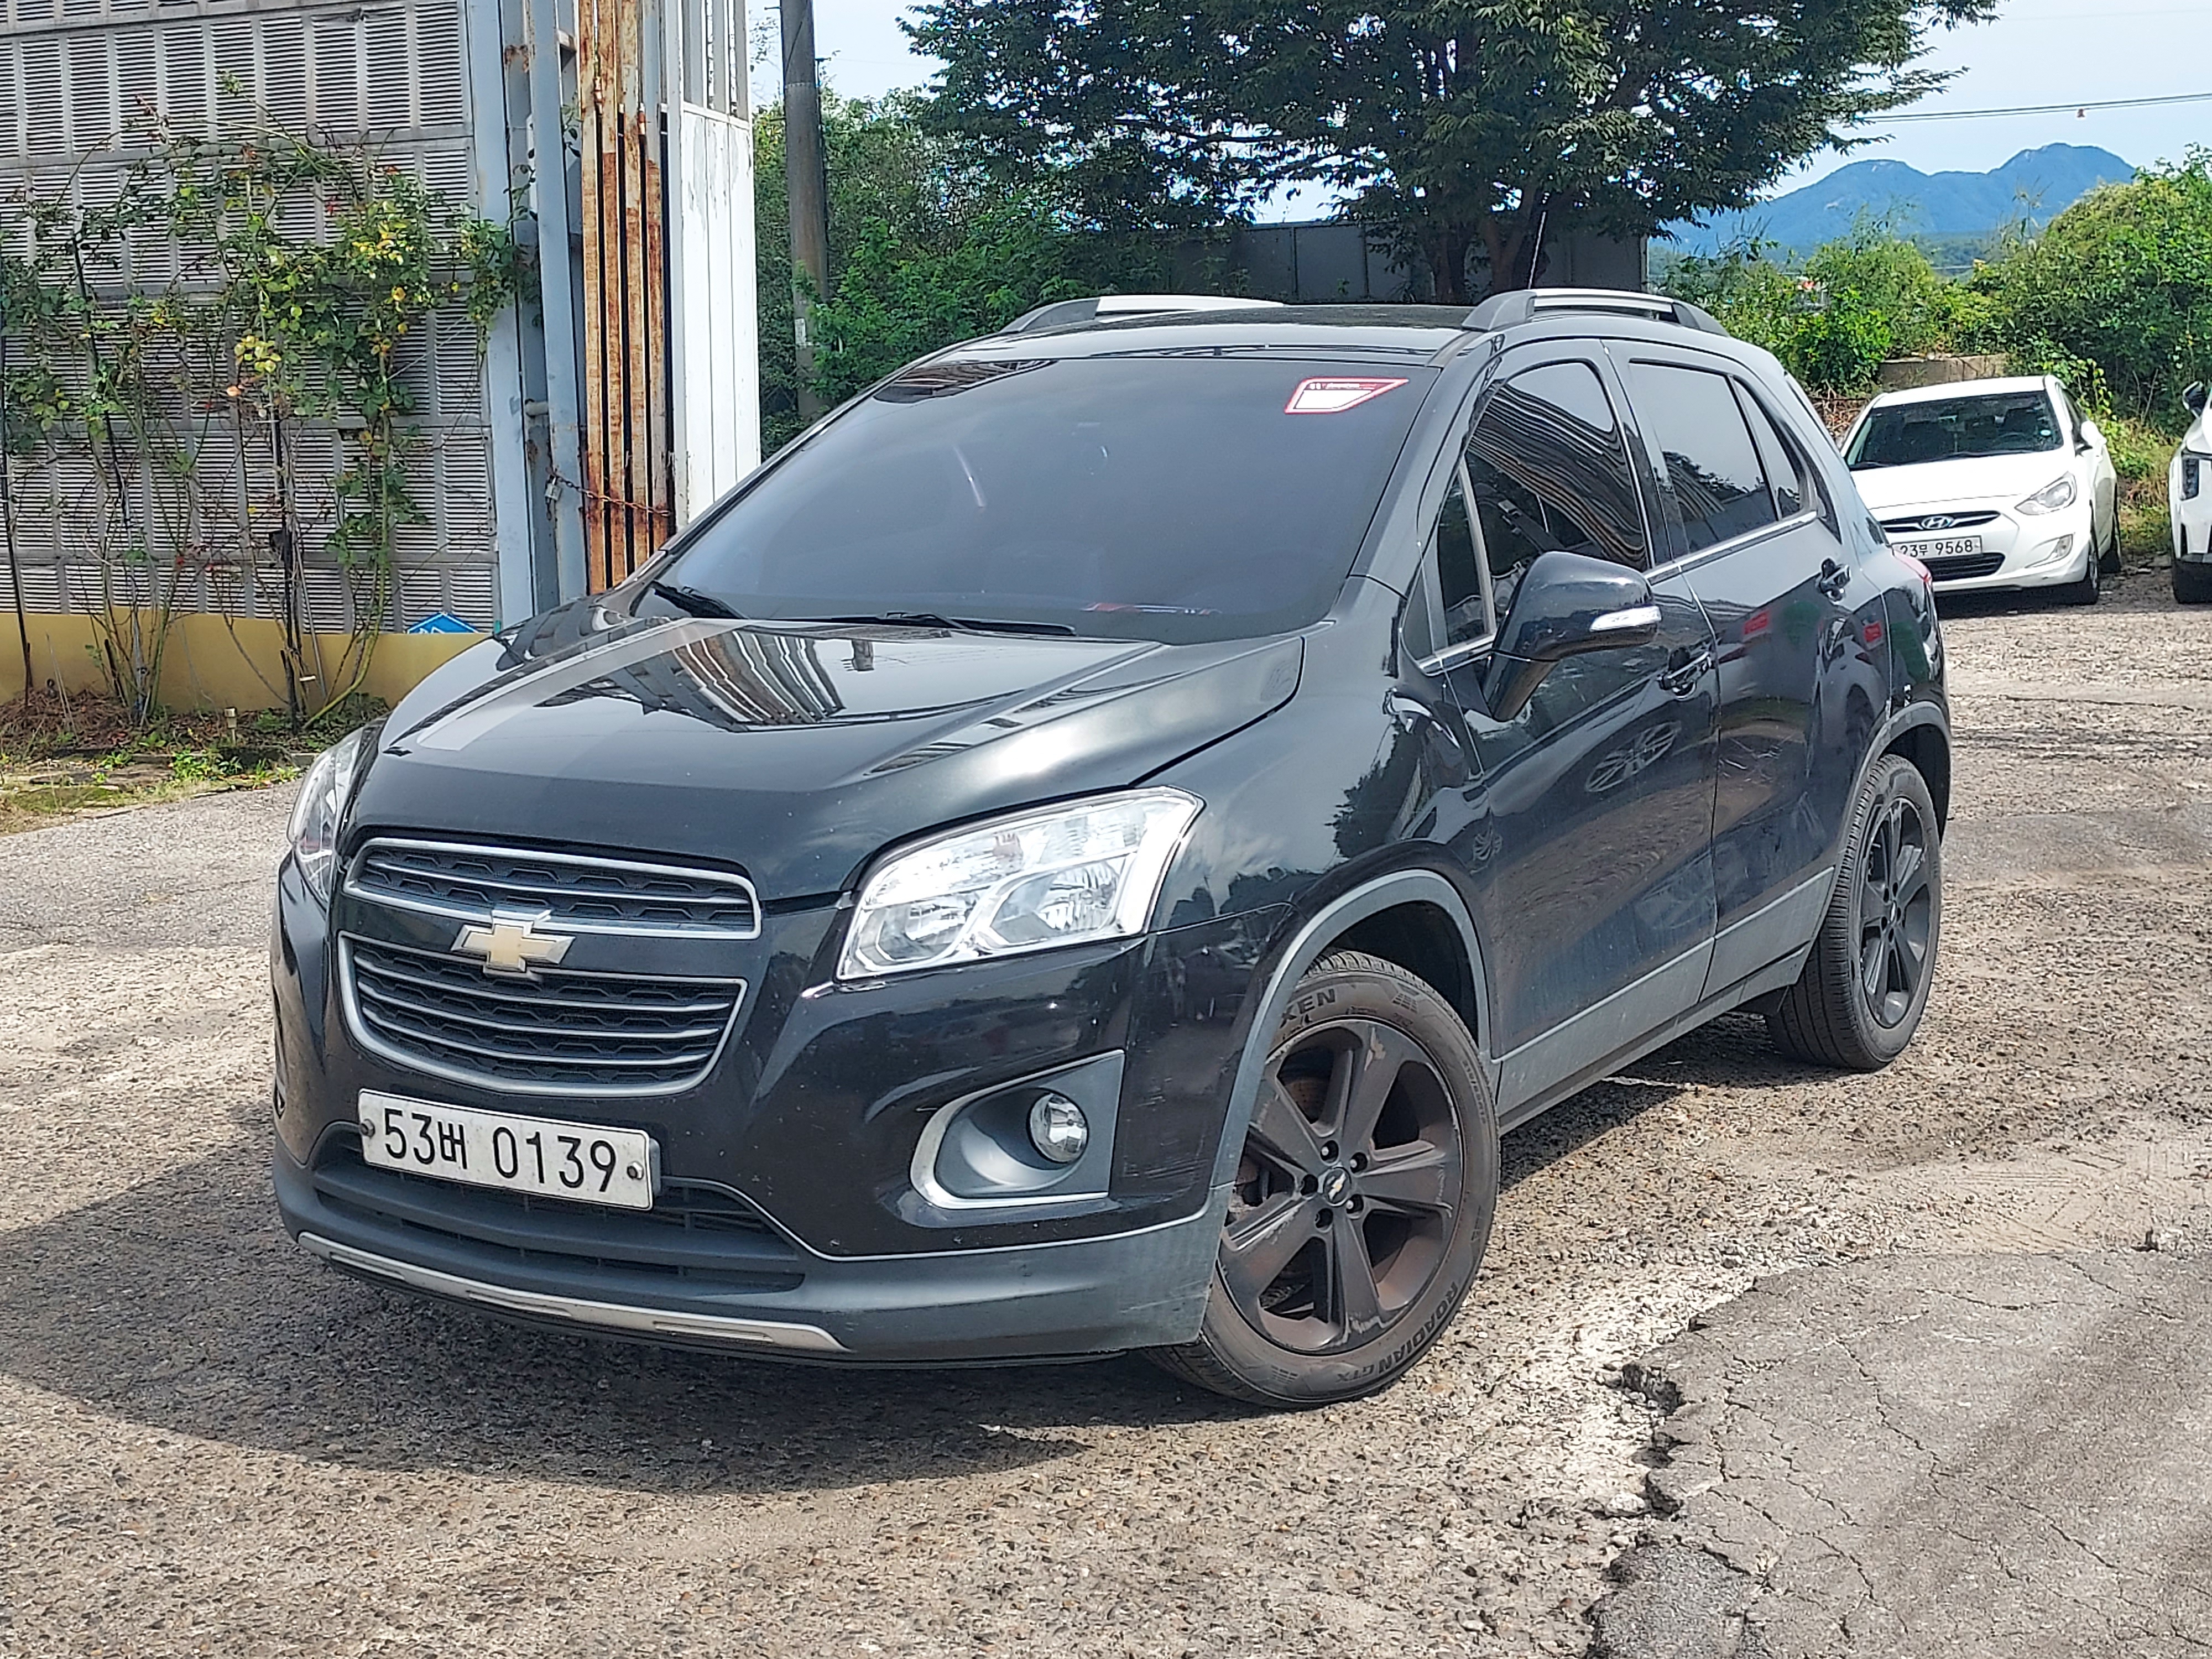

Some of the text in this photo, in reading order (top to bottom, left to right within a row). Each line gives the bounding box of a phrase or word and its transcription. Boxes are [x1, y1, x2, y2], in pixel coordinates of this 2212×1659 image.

[1935, 539, 1973, 555] 9568
[1279, 988, 1336, 1029] XEN
[383, 1107, 617, 1192] 53버 0139
[1378, 1281, 1458, 1374] ROADIAN
